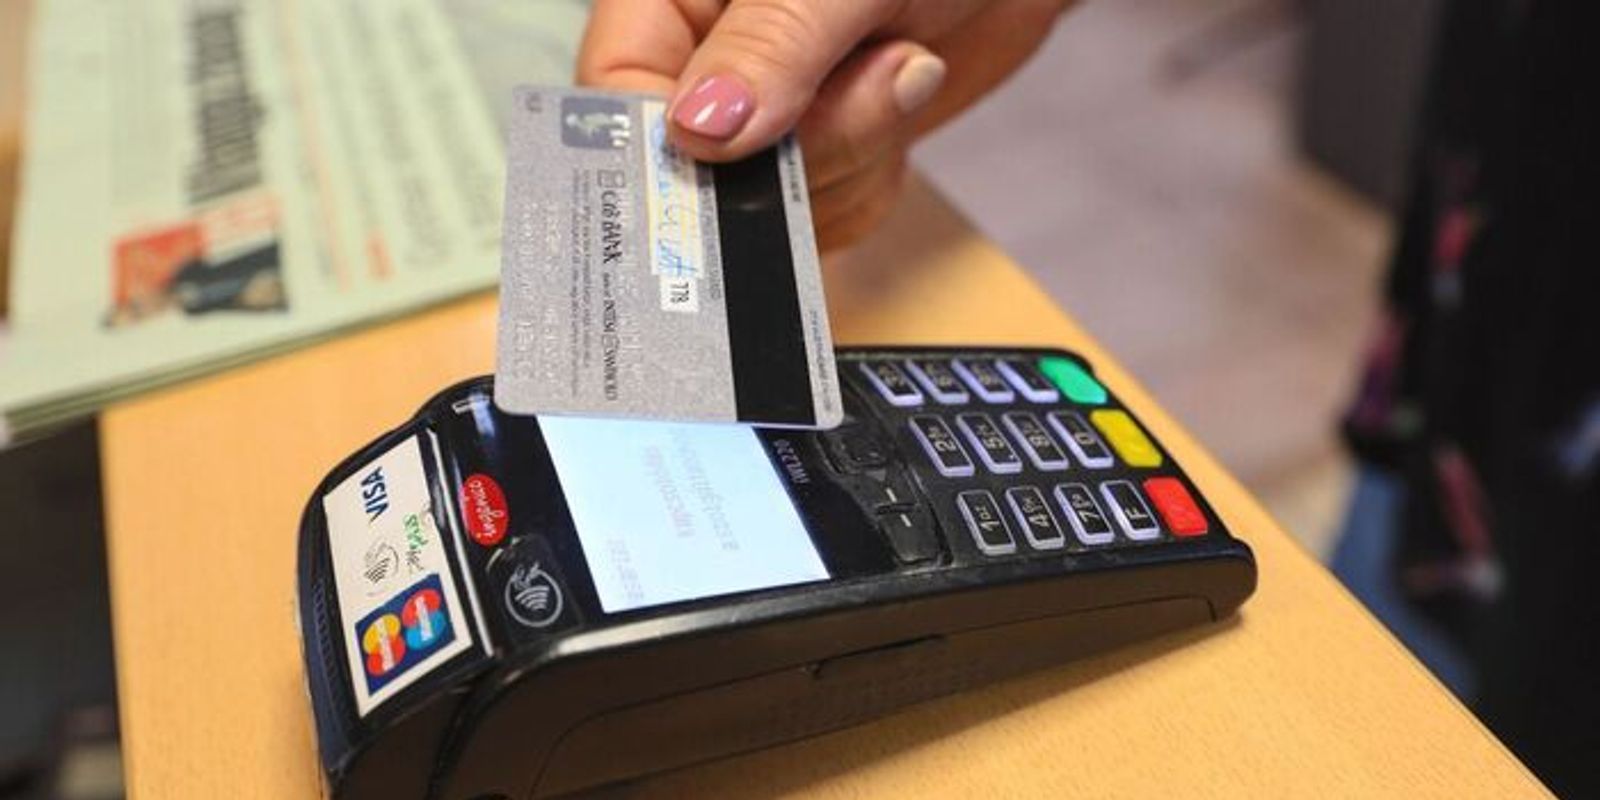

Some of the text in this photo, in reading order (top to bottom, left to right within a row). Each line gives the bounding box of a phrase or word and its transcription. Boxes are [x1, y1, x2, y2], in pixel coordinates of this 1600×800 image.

[669, 282, 690, 304] 778
[360, 467, 389, 522] VISA
[463, 480, 505, 539] ingenico
[1124, 506, 1149, 521] F
